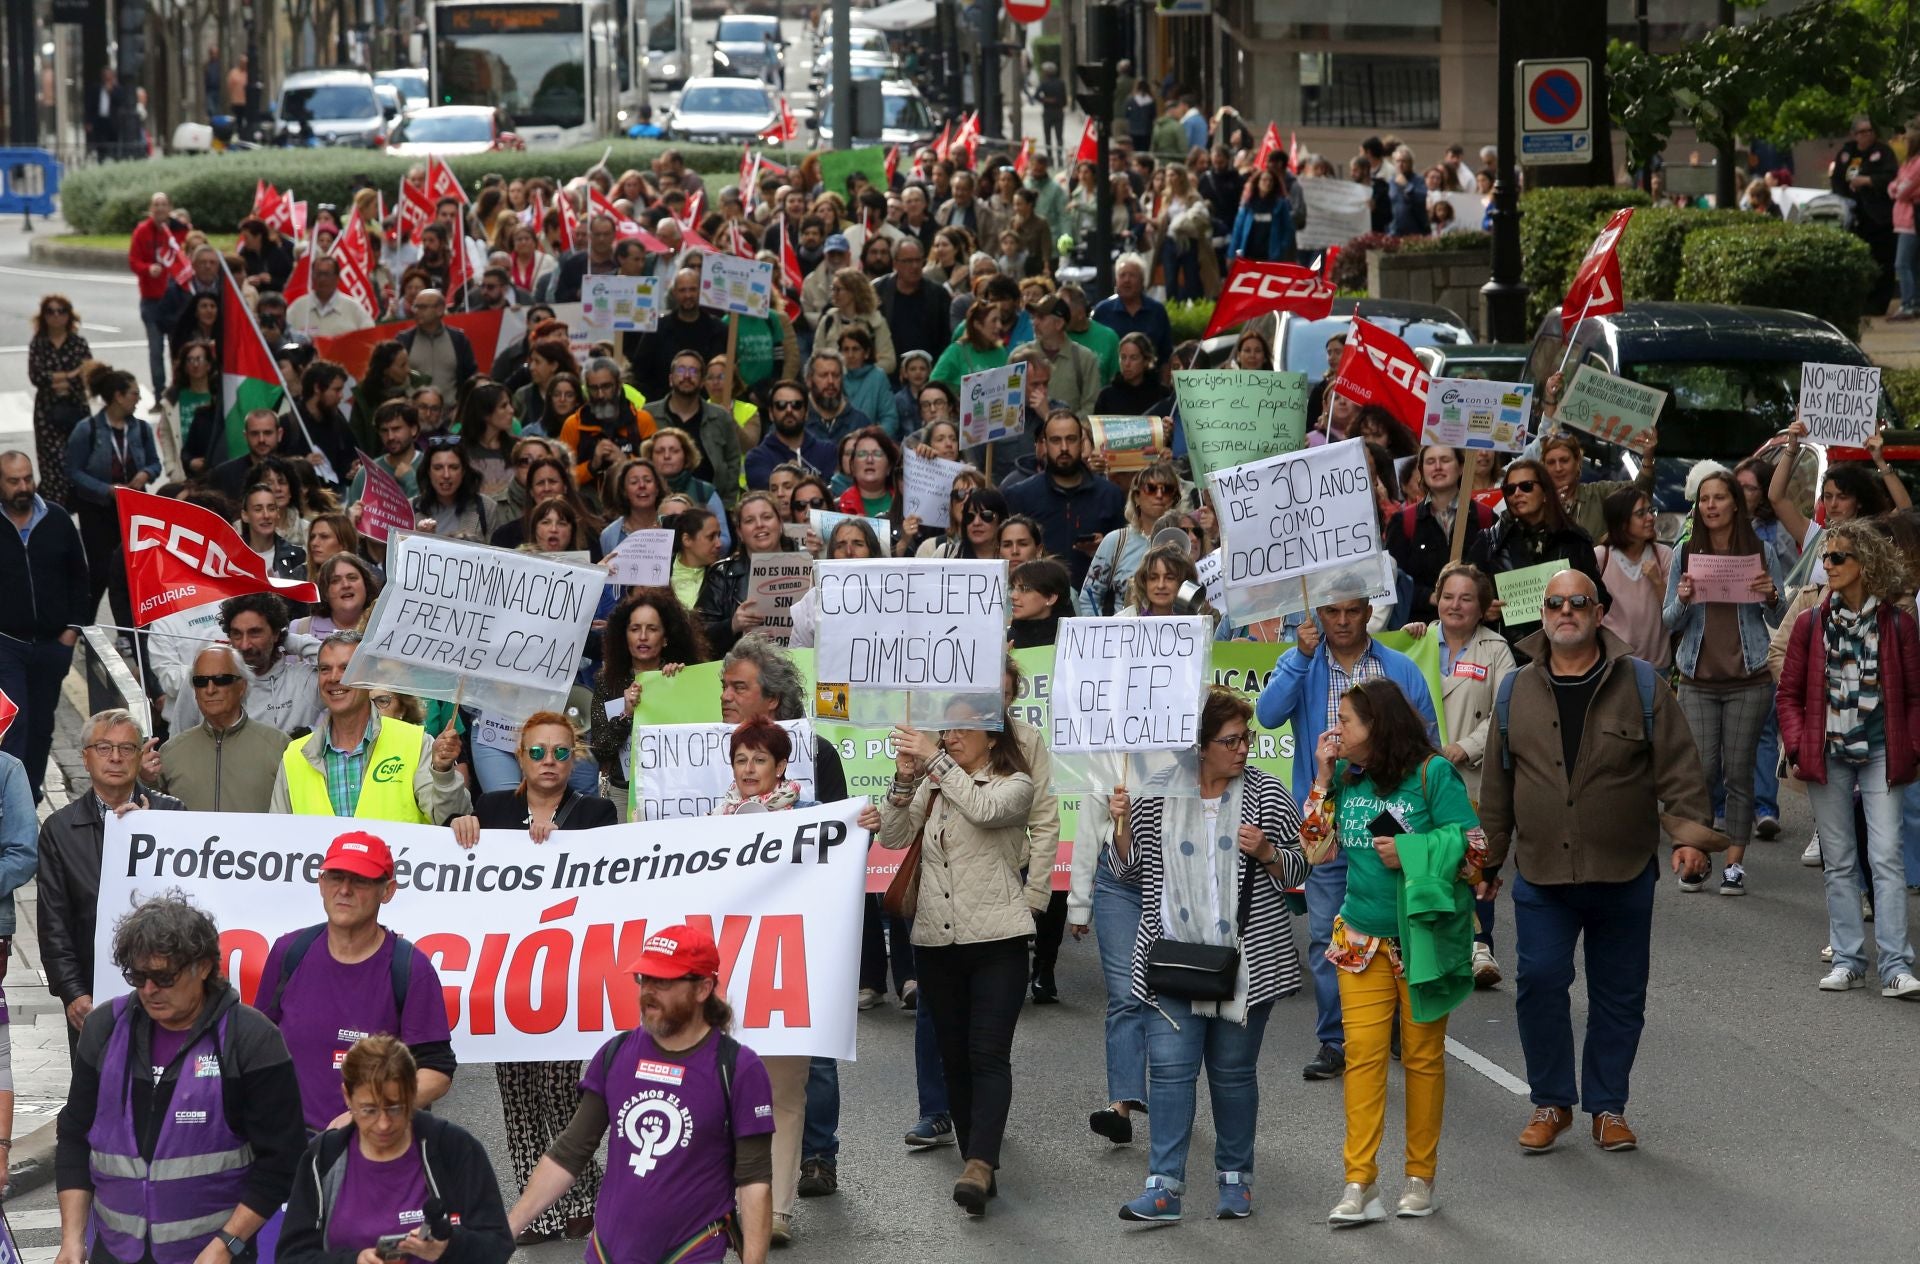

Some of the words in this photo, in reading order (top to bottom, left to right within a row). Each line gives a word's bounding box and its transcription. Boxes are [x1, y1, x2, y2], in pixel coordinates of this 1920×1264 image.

[1247, 374, 1286, 396] Deja
[1803, 366, 1825, 390] NO
[1826, 370, 1837, 381] NOS
[1180, 392, 1225, 409] hacer
[1230, 395, 1250, 409] el
[1804, 391, 1823, 409] LAS
[1825, 391, 1873, 417] MEDIAS
[1803, 414, 1872, 442] JORNADAS
[1218, 466, 1260, 498] MÁS
[1267, 458, 1313, 510] 30
[1319, 466, 1368, 500] AÑOS
[1230, 496, 1258, 522] DE
[1269, 505, 1325, 539] COMO
[1231, 522, 1372, 581] DOCENTES
[403, 545, 586, 624] DISCRIMINACIÓN
[753, 567, 767, 577] NO
[768, 567, 779, 577] ES
[781, 566, 800, 577] UNA
[778, 581, 802, 591] VERDAD
[139, 585, 197, 614] ASTURIAS
[774, 596, 793, 608] SIN
[820, 566, 1004, 615] CONSEJERA
[396, 598, 496, 644] FRENTE
[375, 630, 395, 652] A
[400, 633, 487, 672] OTRAS
[495, 630, 576, 681] CCAA
[849, 625, 976, 684] DIMISIÓN
[1063, 619, 1194, 661] INTERINOS
[1079, 680, 1113, 712] DE
[1126, 665, 1173, 711] F.P.
[1054, 717, 1083, 746] EN
[1088, 716, 1117, 746] LA
[1123, 713, 1196, 746] CALLE
[640, 728, 680, 770] SIN
[1344, 819, 1362, 830] DE
[126, 833, 322, 885] Profesore
[385, 845, 545, 893] écnicos
[551, 843, 730, 890] Interinos
[736, 830, 783, 866] de
[790, 819, 849, 865] FP
[639, 1062, 670, 1075] CCOO
[616, 1089, 665, 1138] MARCAMOS
[667, 1092, 681, 1108] EL
[679, 1106, 694, 1148] RITMO
